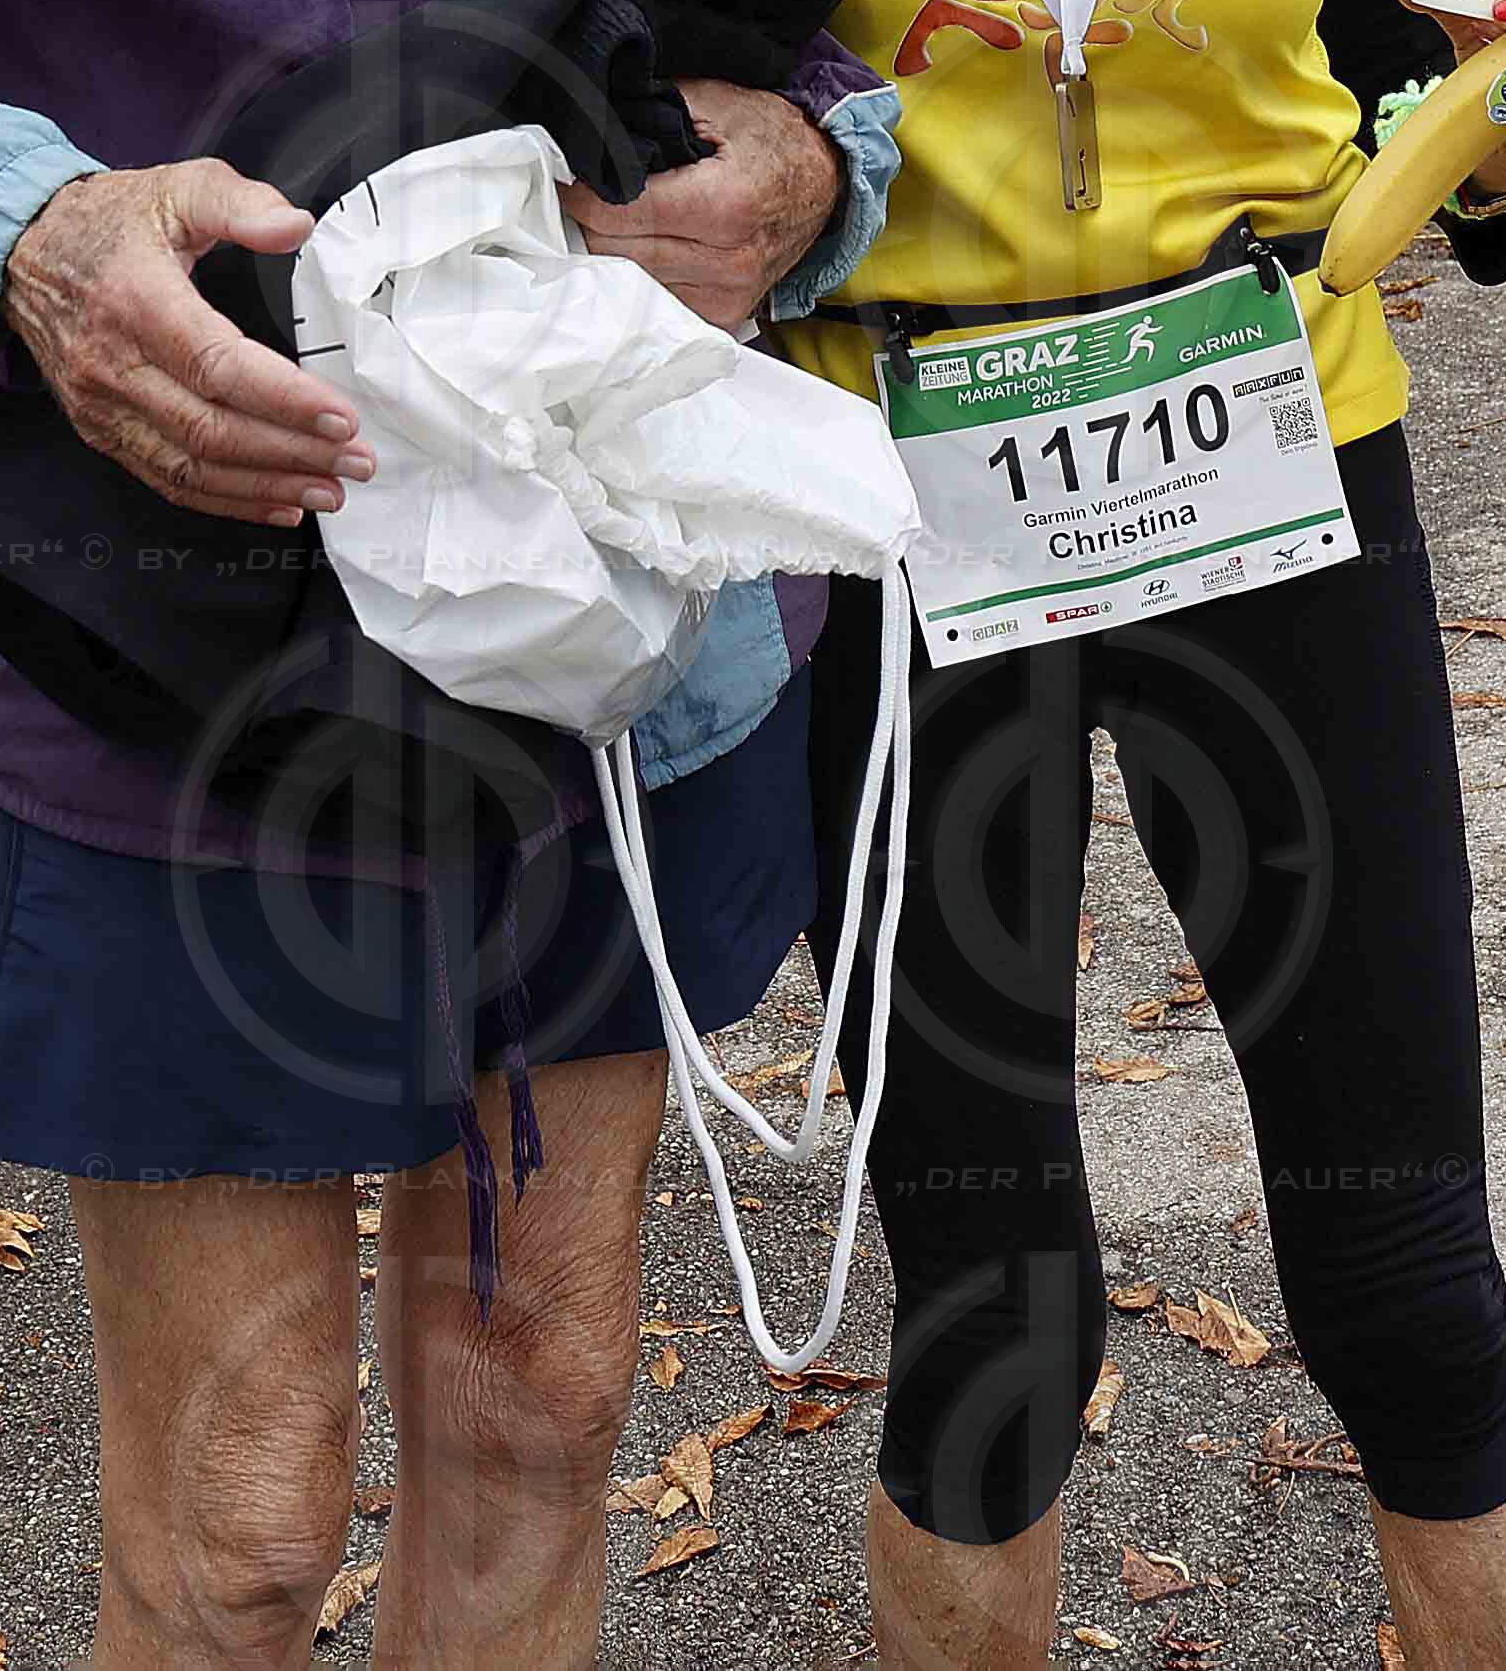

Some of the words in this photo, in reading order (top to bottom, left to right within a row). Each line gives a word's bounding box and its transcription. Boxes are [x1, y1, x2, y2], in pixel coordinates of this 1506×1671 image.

[1179, 324, 1265, 364] GARMIN
[921, 360, 966, 376] KLEINE
[976, 334, 1079, 381] GRAZ
[922, 371, 969, 388] ZEITUNG
[957, 373, 1054, 406] MARATHON
[1032, 389, 1072, 410] 2022
[988, 384, 1230, 502] 11710
[1023, 506, 1087, 529] Garmin
[1091, 468, 1220, 517] Viertelmarathon
[1049, 503, 1198, 559] Christina
[1200, 566, 1230, 580] WIENER
[1141, 592, 1179, 608] HYUNDAI
[1055, 605, 1098, 621] SPAR
[972, 619, 1019, 642] GRAZ
